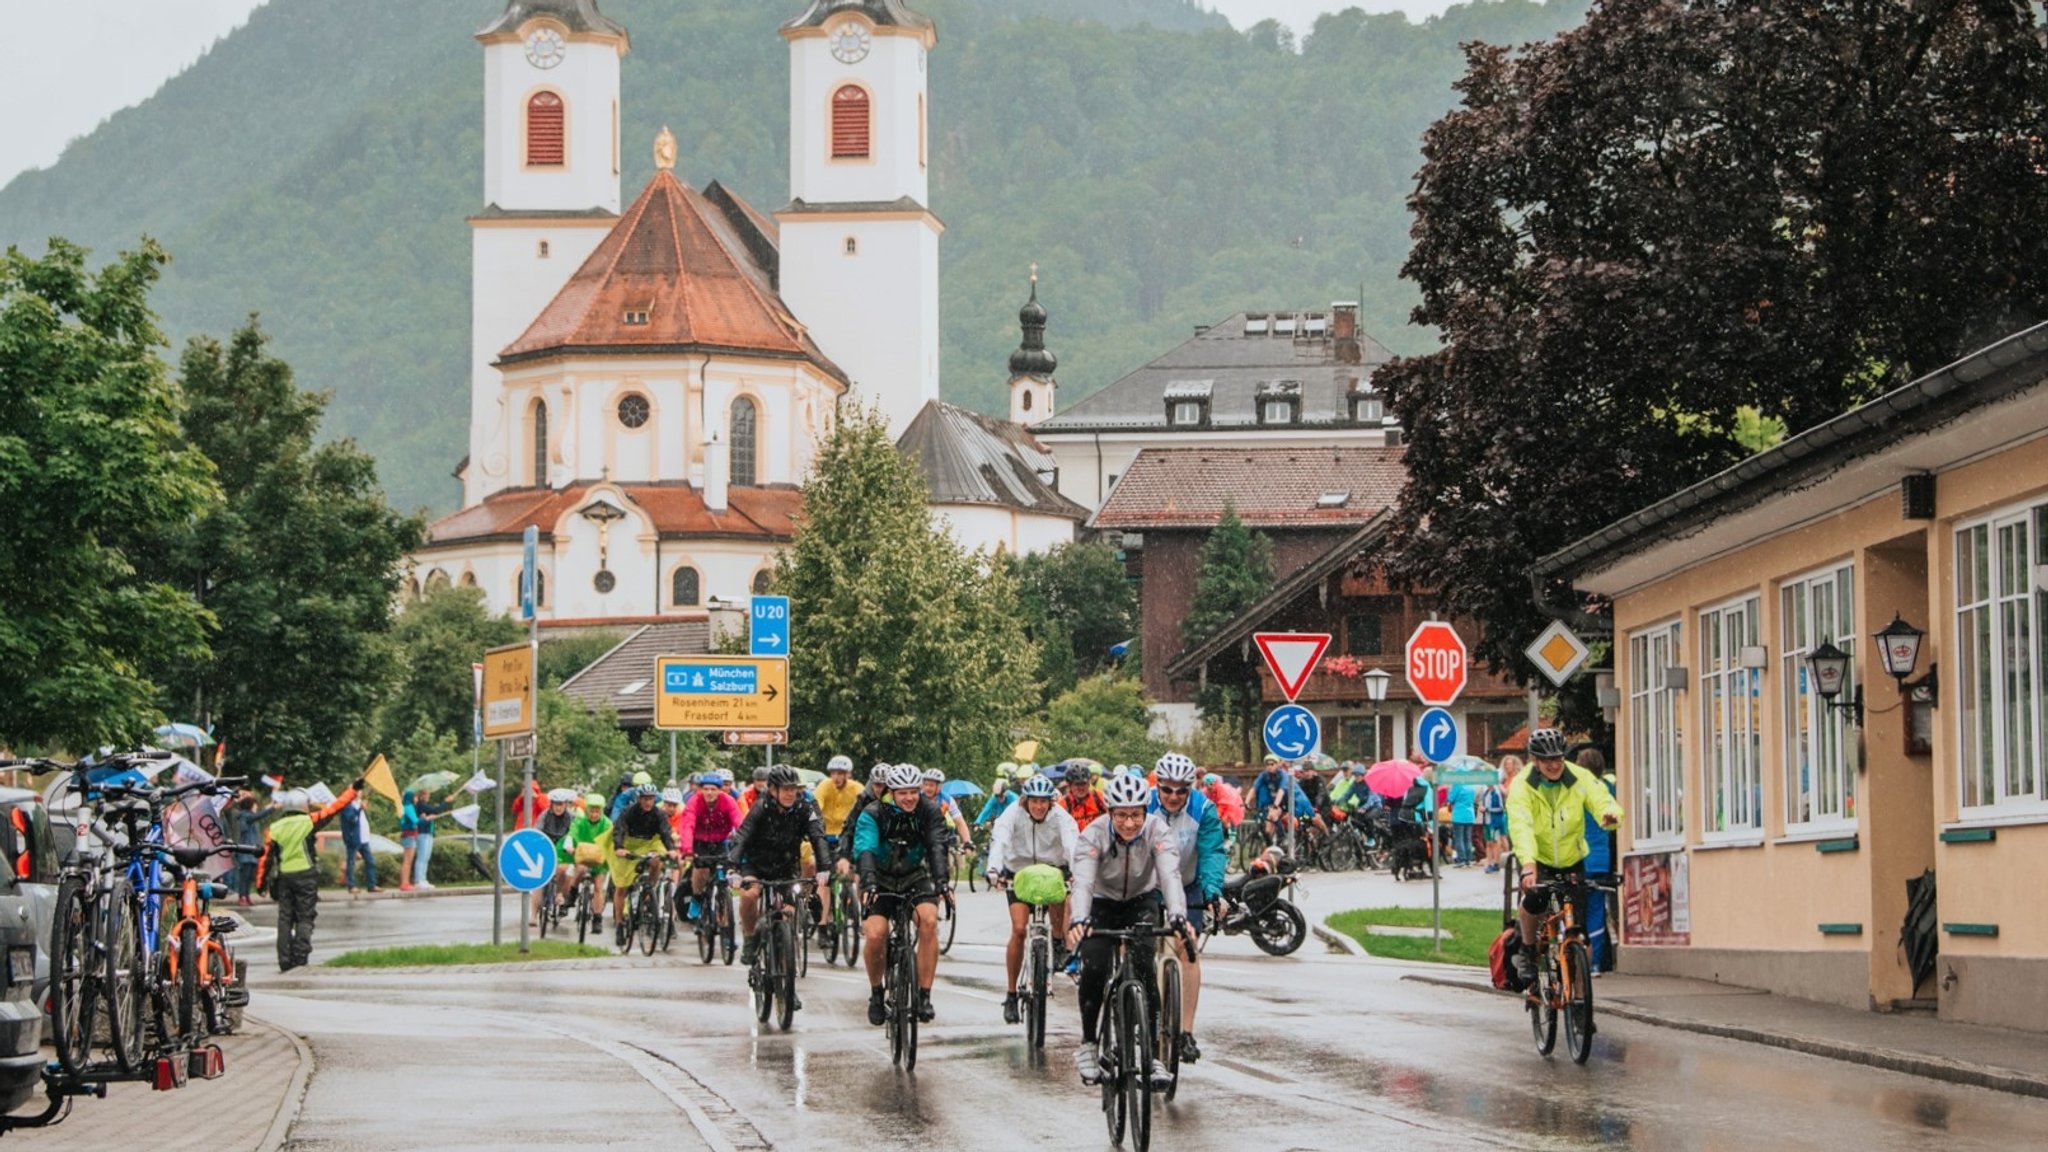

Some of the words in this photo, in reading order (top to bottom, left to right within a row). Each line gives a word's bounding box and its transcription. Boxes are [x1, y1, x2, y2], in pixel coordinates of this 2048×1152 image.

[755, 605, 765, 619] U
[767, 605, 784, 619] 20
[1413, 648, 1460, 680] STOP
[709, 668, 755, 678] München
[710, 681, 755, 693] Salzburg
[672, 697, 729, 707] Rosenheim
[733, 698, 743, 707] 21
[684, 710, 729, 720] Frasdorf
[737, 711, 744, 720] 4
